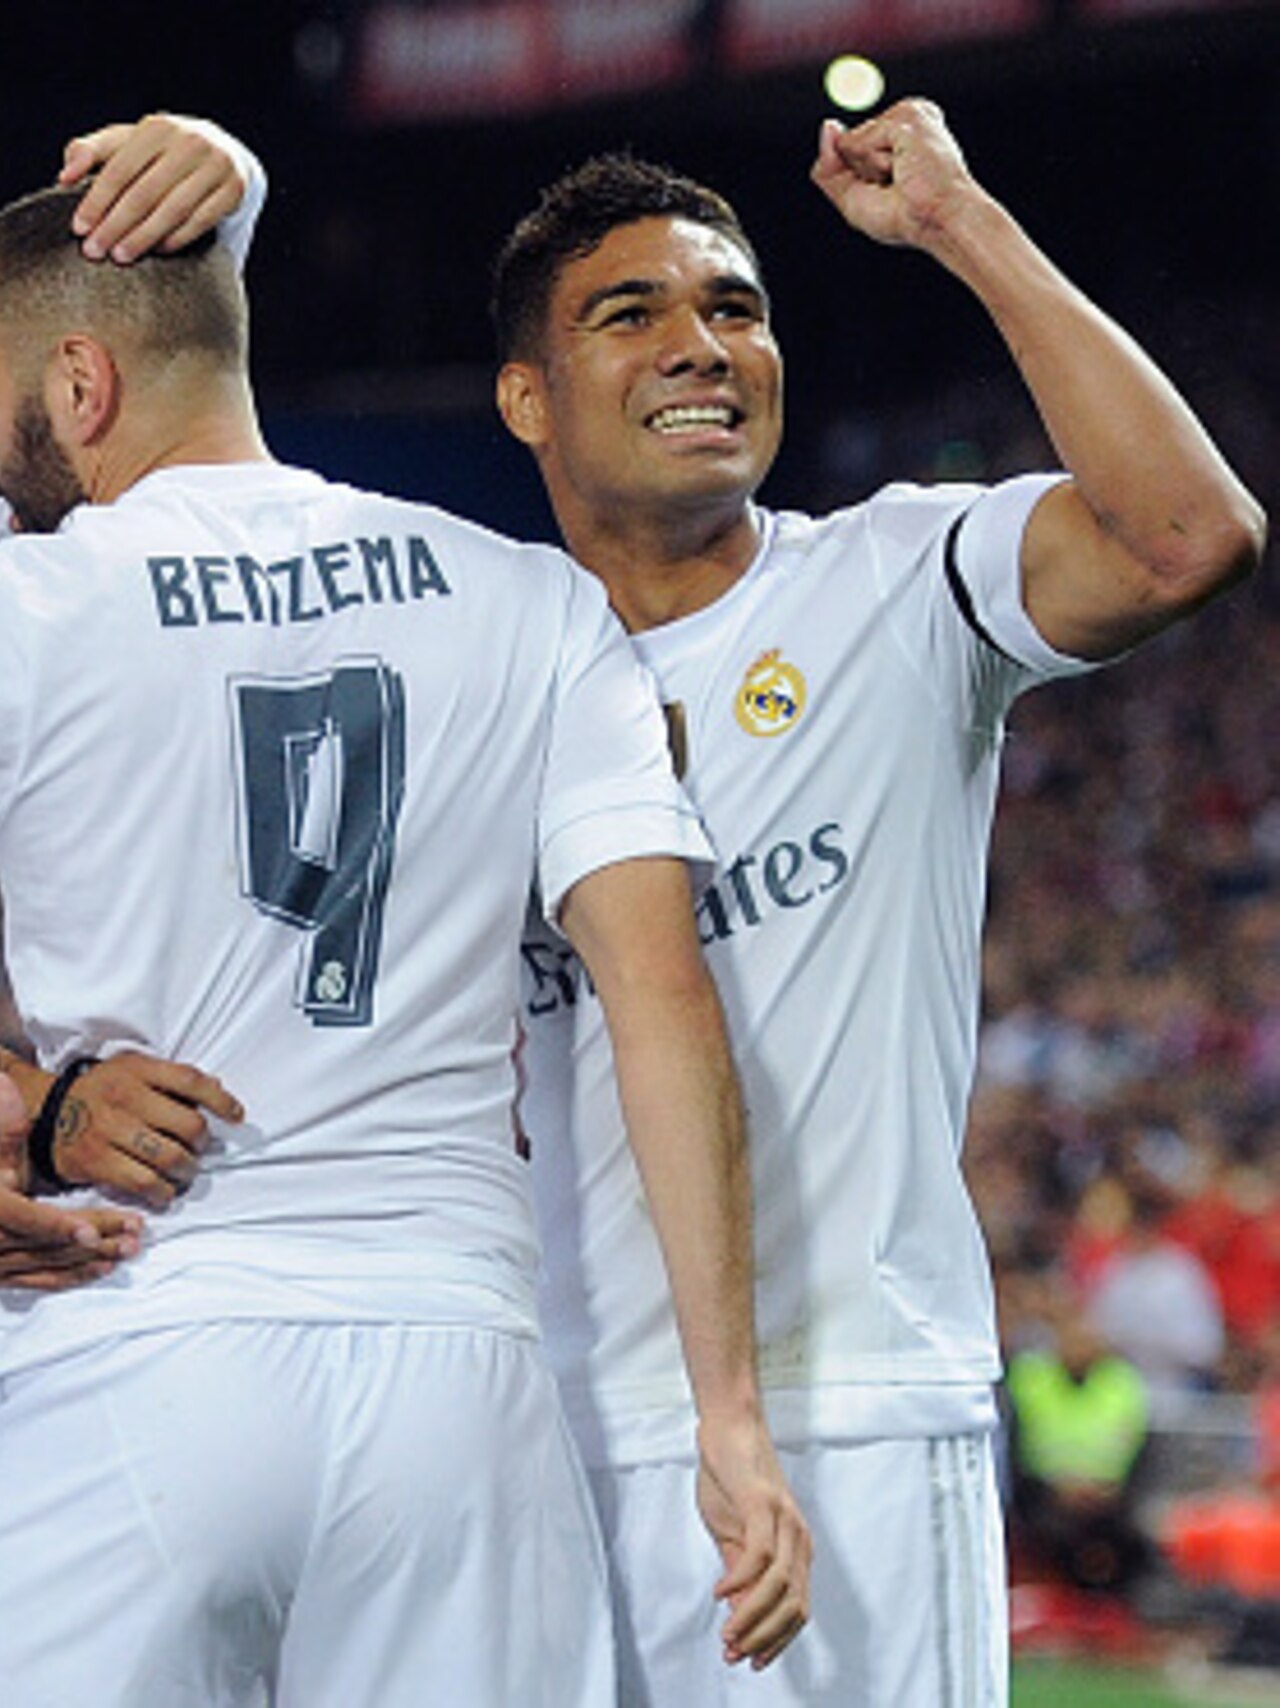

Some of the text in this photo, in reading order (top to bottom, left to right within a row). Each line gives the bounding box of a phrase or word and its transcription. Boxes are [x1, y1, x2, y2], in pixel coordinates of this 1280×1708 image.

[146, 535, 451, 627] BENZEMA
[226, 653, 407, 1027] 9
[520, 822, 849, 1016] Eates
